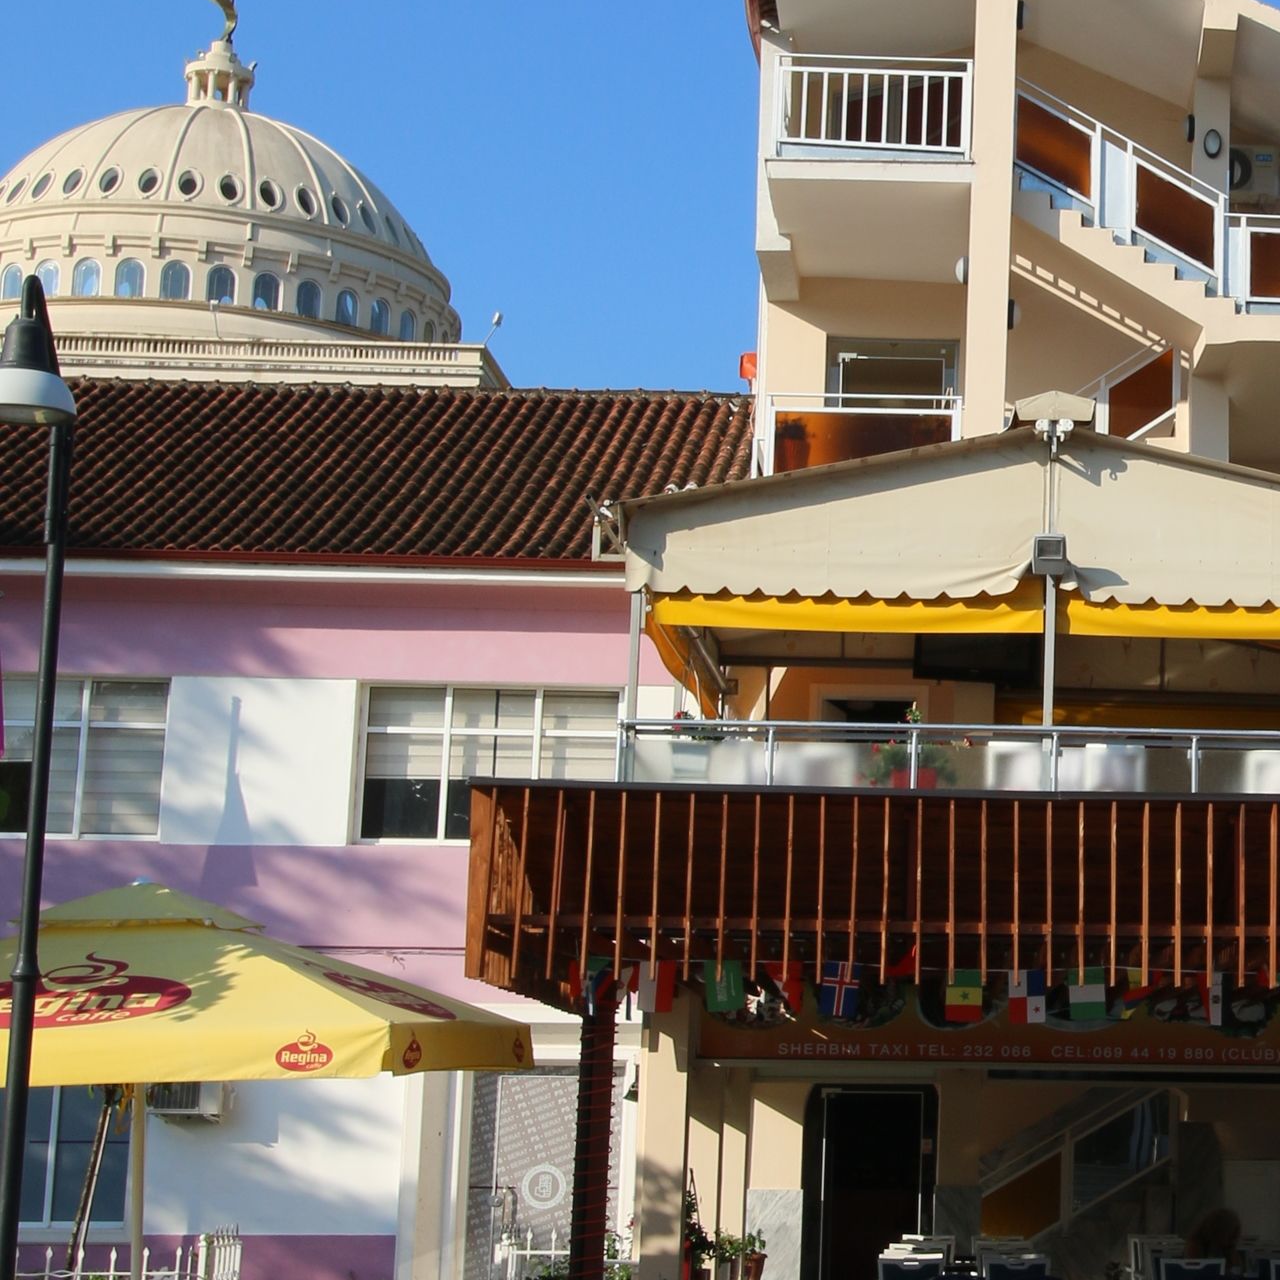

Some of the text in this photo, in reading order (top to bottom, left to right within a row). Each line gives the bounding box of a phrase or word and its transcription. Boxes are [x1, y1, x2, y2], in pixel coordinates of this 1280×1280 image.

[280, 1050, 328, 1066] Regina
[778, 1042, 861, 1056] SHERBIM
[869, 1043, 910, 1056] TAXI
[917, 1043, 955, 1057] TEL:
[963, 1045, 993, 1057] 232
[1130, 1046, 1150, 1059] 44
[1159, 1047, 1177, 1060] 19
